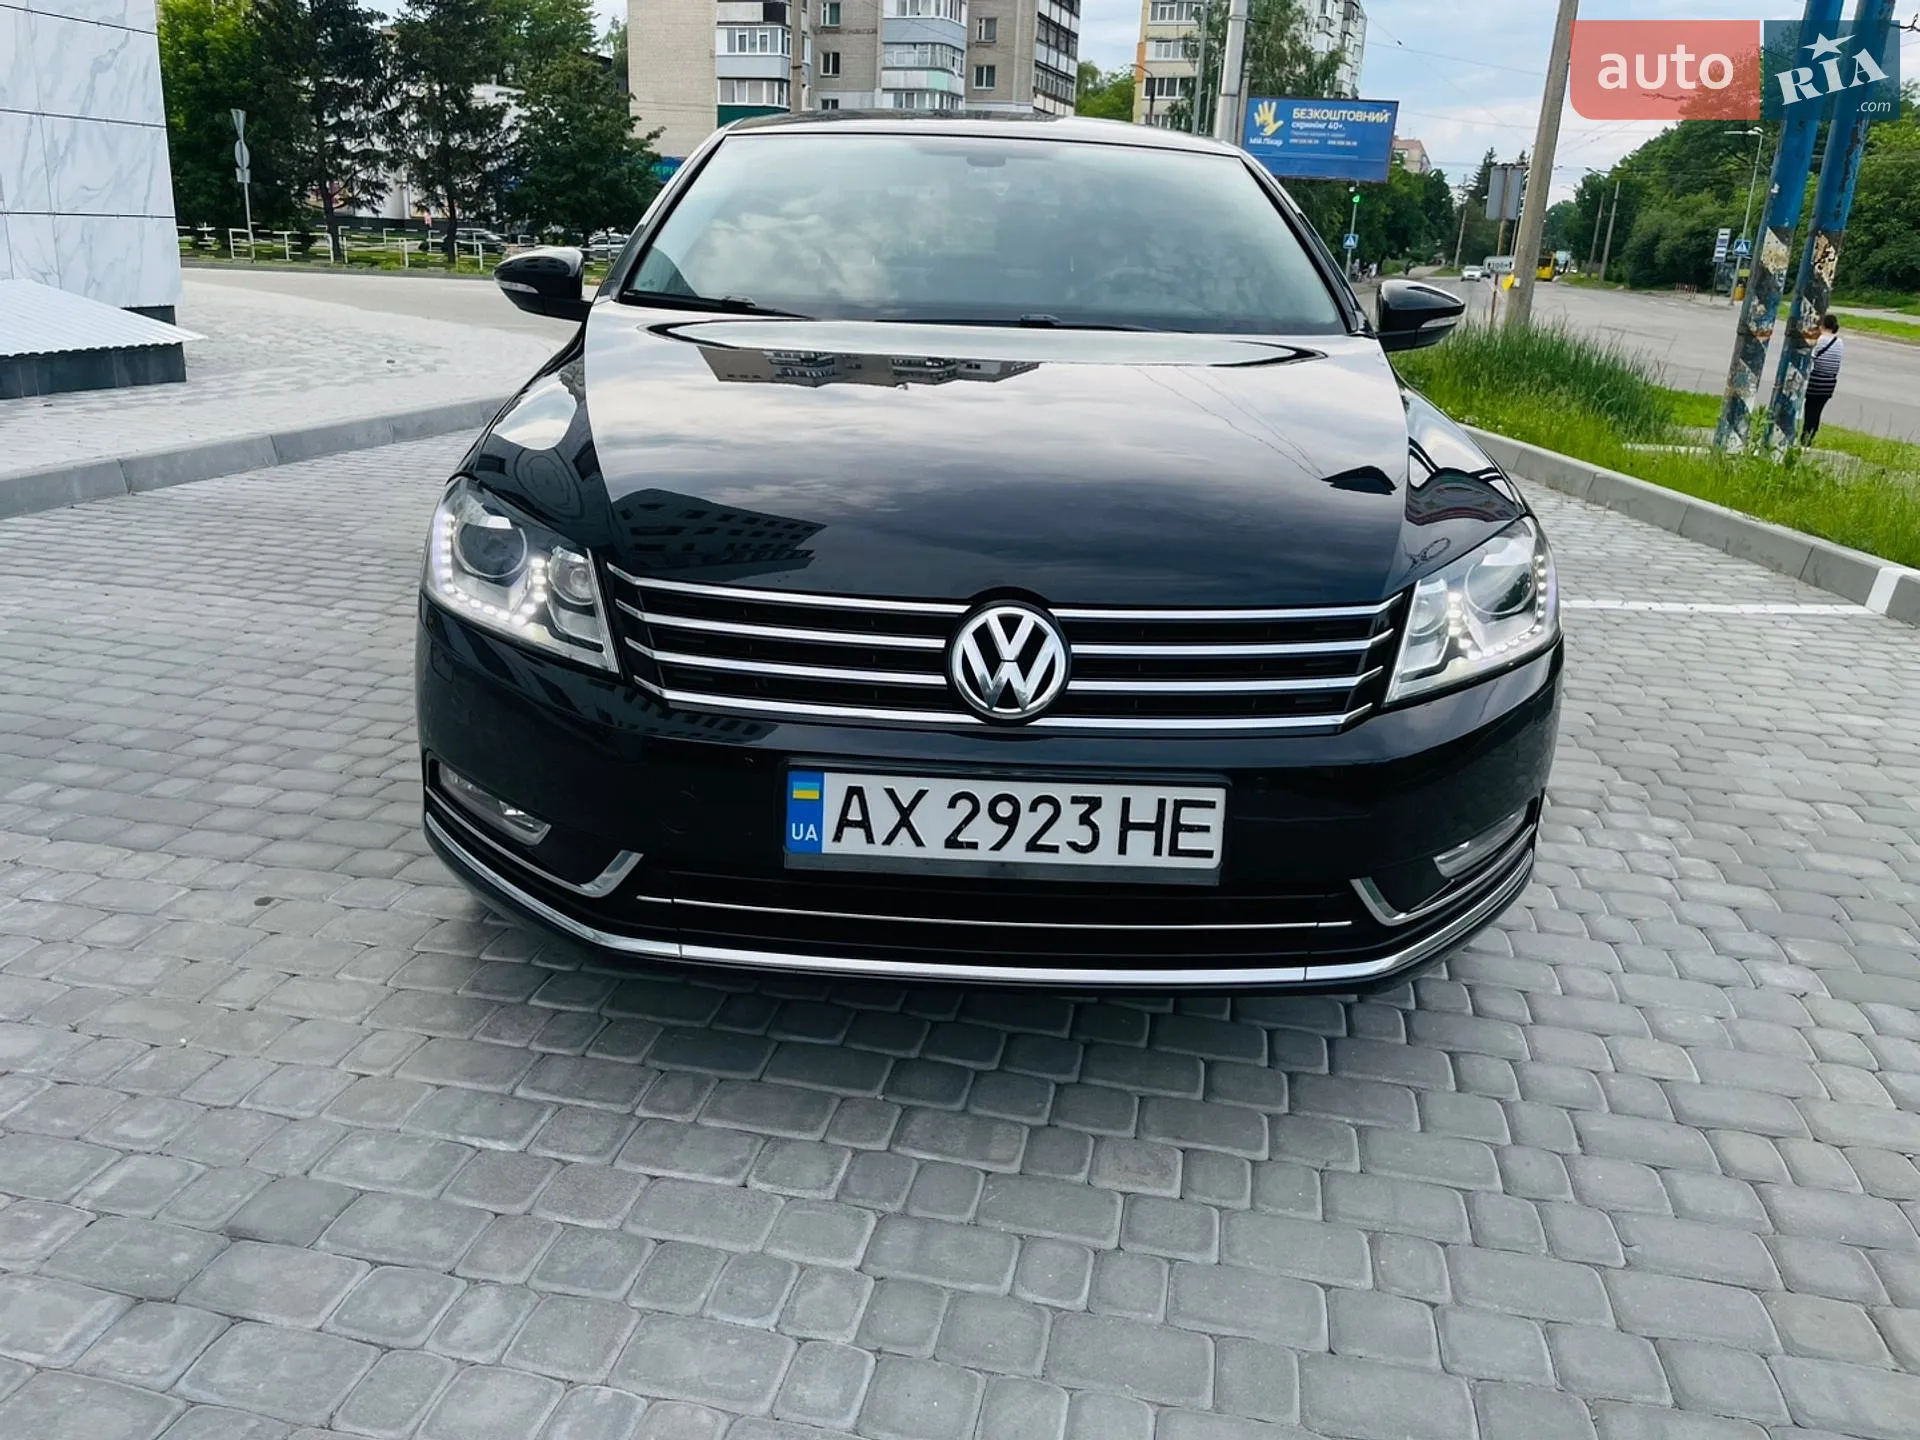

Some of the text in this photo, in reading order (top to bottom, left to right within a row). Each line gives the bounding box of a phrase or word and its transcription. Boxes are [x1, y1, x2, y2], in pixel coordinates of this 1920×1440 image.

[1292, 107, 1391, 124] БЕЗКОШТОВНИЙ
[956, 606, 1064, 716] VW
[791, 822, 819, 842] UA
[831, 785, 1217, 859] AX 2923 HE
